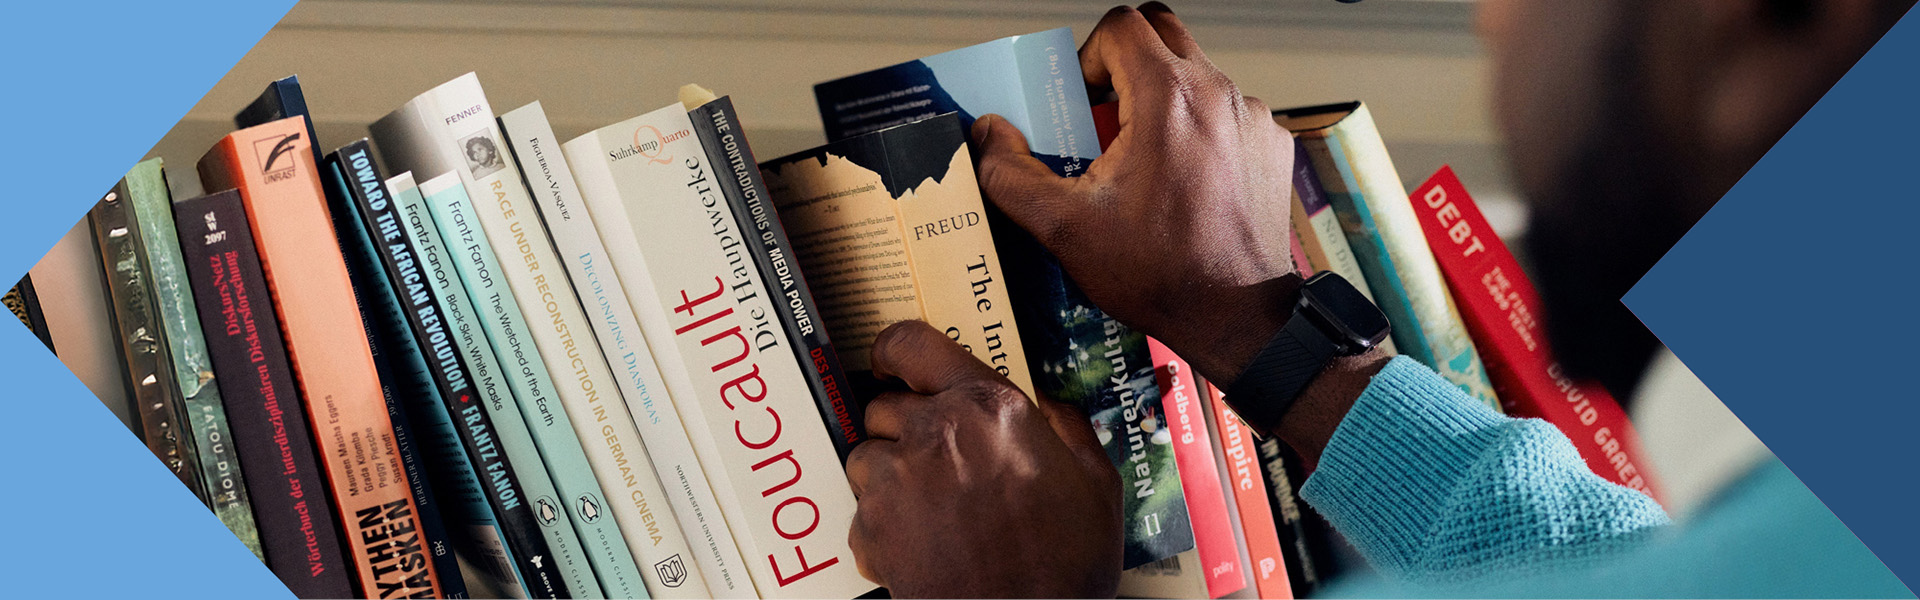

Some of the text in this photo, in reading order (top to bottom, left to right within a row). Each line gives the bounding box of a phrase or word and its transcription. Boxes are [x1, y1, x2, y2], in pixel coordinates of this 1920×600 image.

[445, 104, 483, 126] FENNER
[1055, 78, 1072, 130] Amelang
[264, 169, 297, 184] UNRAST
[609, 138, 658, 162] Suhrkamp
[1067, 134, 1081, 170] Katrin
[205, 230, 226, 245] 2097
[685, 156, 779, 353] Die Hauptwerke
[914, 210, 981, 241] FREUD
[1424, 184, 1485, 257] DEBT
[210, 254, 241, 336] DiskursNetz
[405, 203, 503, 411] Frantz Fanon Black Skin, White Masks
[712, 109, 859, 444] THE CONTRADICTIONS OF MEDIA POWER DES FREEDMAN
[966, 254, 993, 313] The
[350, 149, 387, 211] TOWARD
[376, 211, 401, 242] THE
[389, 243, 430, 306] AFRICAN
[418, 305, 468, 393] REVOLUTION
[462, 404, 496, 462] FRANTZ
[486, 459, 521, 511] FANON
[448, 200, 554, 427] Frantz Fanon The Wretched of the Earth
[490, 180, 663, 547] RACE UNDER RECONSTRUCTION IN GERMAN CINEMA
[623, 351, 661, 425] DIASPORAS
[1547, 362, 1598, 426] DAVID
[225, 250, 325, 577] Wörterbuch der interdisziplinären Diskursforschung
[674, 275, 839, 587] Foucault
[1167, 360, 1194, 445] Goldberg
[202, 405, 239, 510] FATOU DIOME
[325, 394, 360, 497] Maureen Maisha Eggers
[351, 431, 374, 493] Grada Kilomba
[365, 426, 388, 489] Peggy Piesche
[381, 432, 403, 484] Susan Arndt
[1223, 409, 1253, 490] Empire
[355, 505, 405, 599] YTHEN
[597, 528, 616, 563] MODERN
[675, 464, 734, 591] NORTHWESTERN UNIVERSITY PRESS
[540, 572, 553, 592] GROVE
[554, 530, 589, 599] MODERN CLASSI
[1213, 561, 1234, 579] polity
